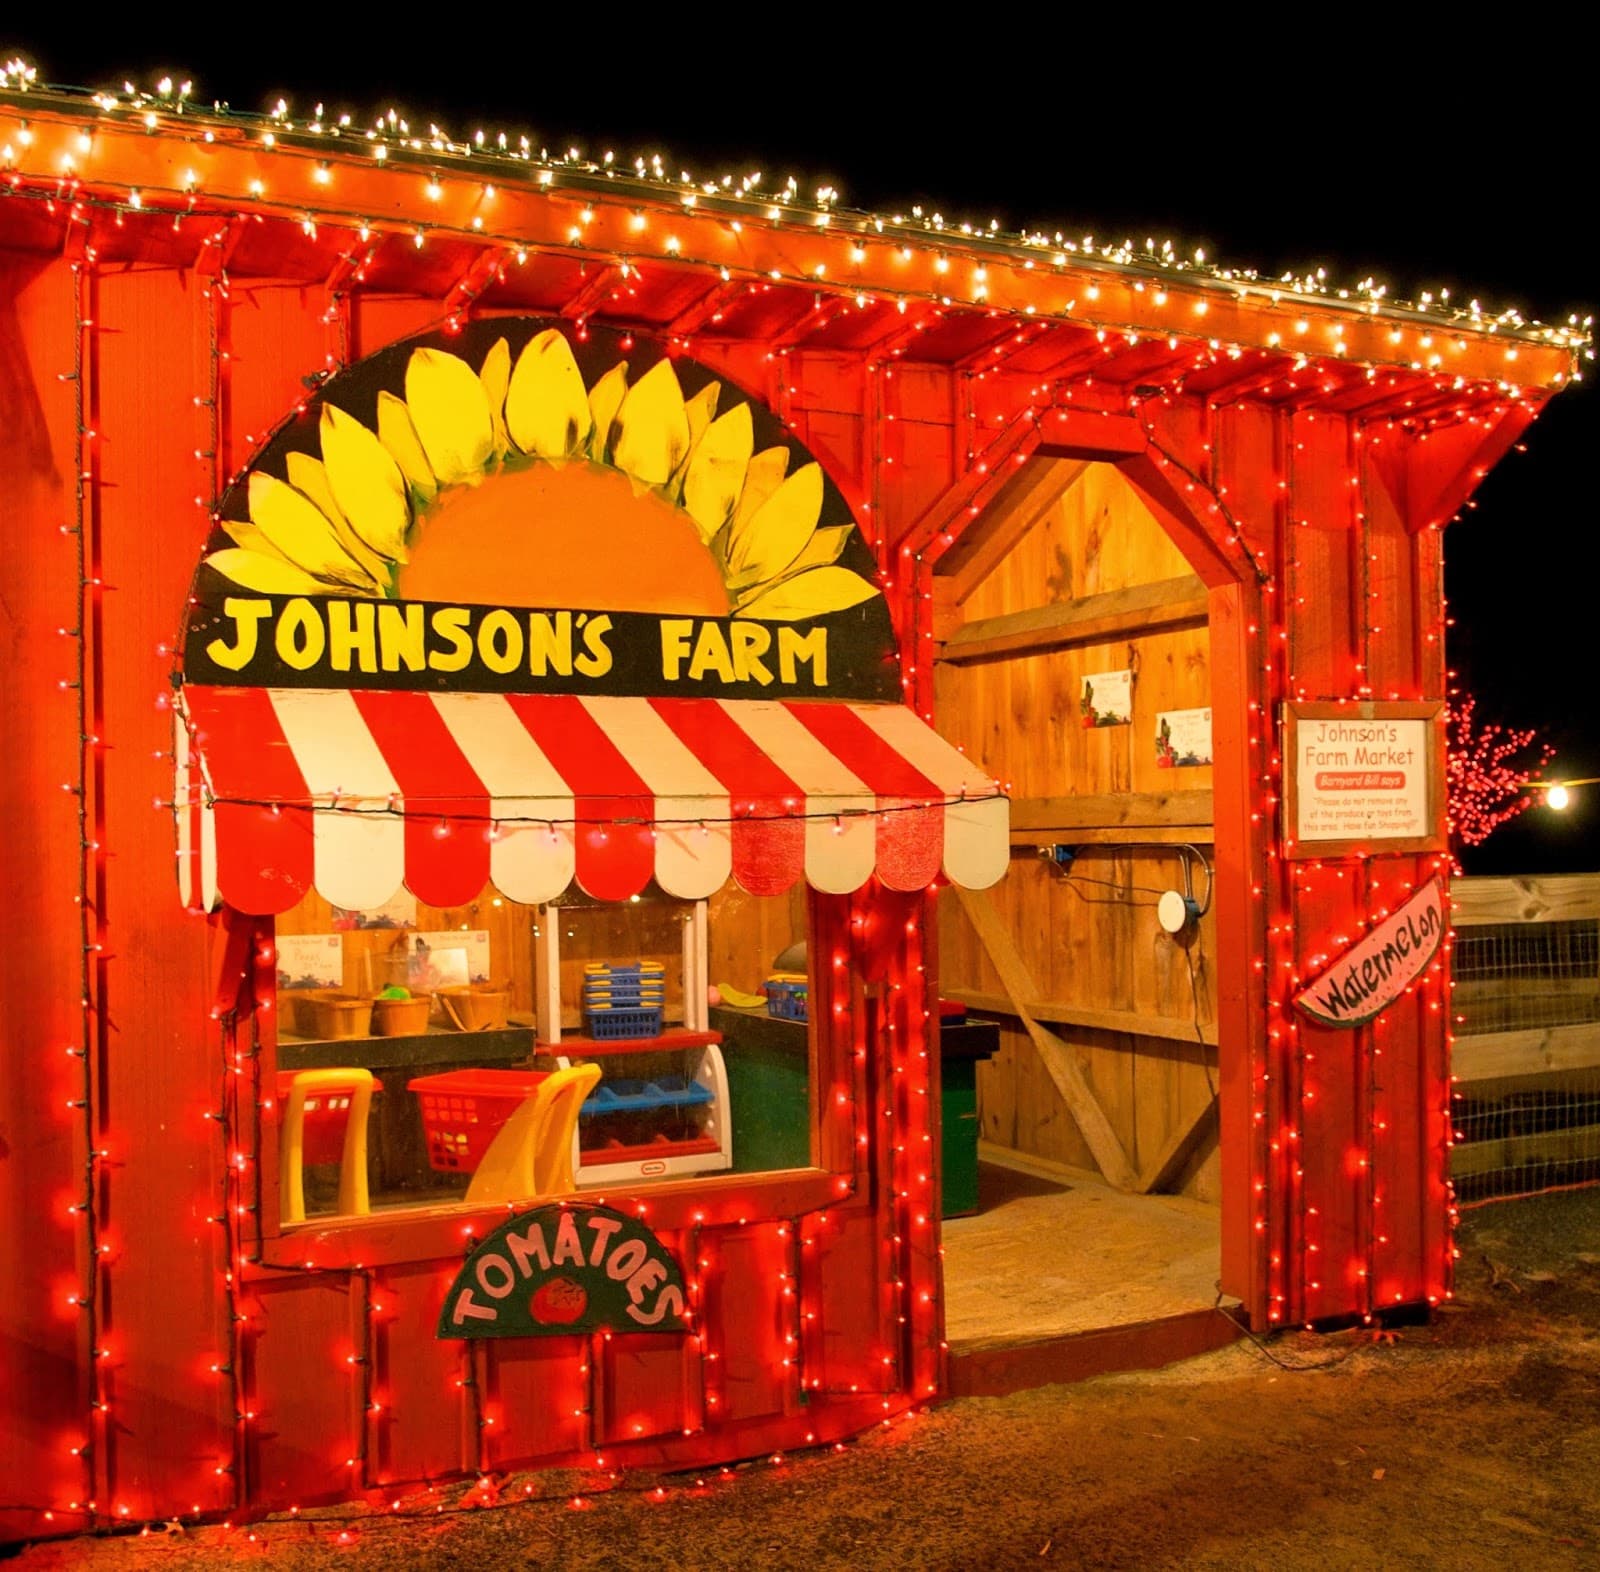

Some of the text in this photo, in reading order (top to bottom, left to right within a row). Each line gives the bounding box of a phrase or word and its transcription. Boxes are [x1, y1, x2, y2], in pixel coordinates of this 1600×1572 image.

[206, 598, 827, 686] JOHNSON'S FARM
[1317, 723, 1397, 743] Johnson's
[1306, 746, 1414, 766] Farm Market
[1320, 774, 1401, 789] Barnyard Bill says
[1342, 797, 1351, 806] do
[1353, 797, 1365, 806] not
[1310, 809, 1318, 819] of
[1320, 809, 1333, 818] the
[1336, 809, 1364, 819] produce
[1395, 808, 1412, 817] from
[1316, 905, 1440, 1017] Watermelon
[453, 1212, 684, 1325] TOMATOES
